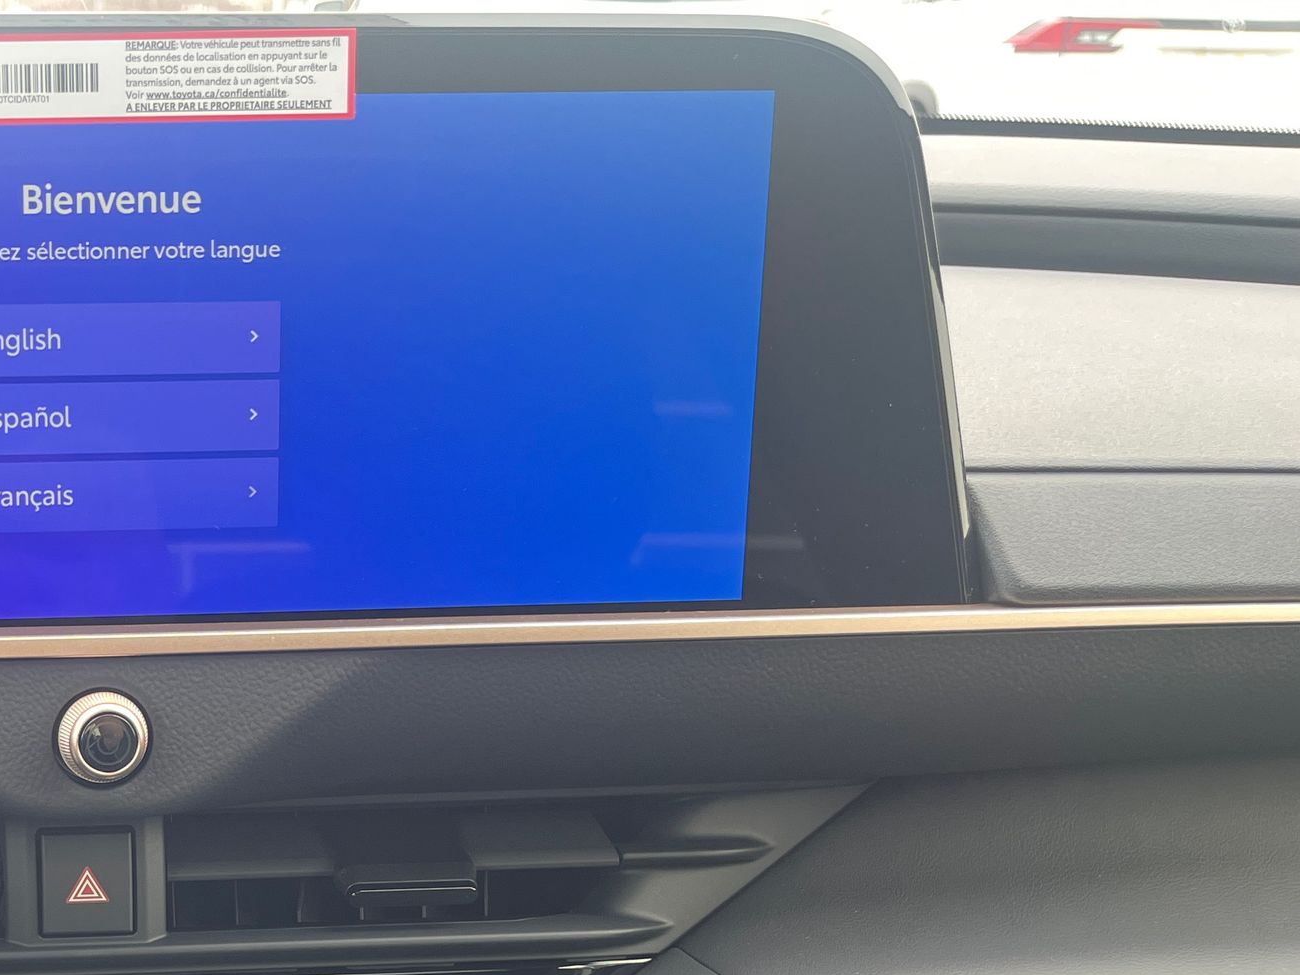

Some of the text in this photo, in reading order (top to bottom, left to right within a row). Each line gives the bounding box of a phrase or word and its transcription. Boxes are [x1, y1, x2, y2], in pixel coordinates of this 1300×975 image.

[125, 41, 178, 51] REMARQUE:
[180, 40, 202, 49] Votre
[204, 39, 238, 48] véhicule
[240, 40, 260, 50] peut
[262, 39, 310, 48] transmettre
[332, 38, 341, 47] fil
[125, 54, 141, 62] des
[143, 53, 180, 62] données
[183, 53, 194, 61] de
[196, 52, 245, 61] localisation
[261, 52, 302, 62] appuyant
[320, 51, 328, 59] le
[126, 66, 157, 75] bouton
[160, 65, 178, 74] SOS
[223, 64, 234, 73] de
[236, 64, 274, 73] collision.
[277, 64, 296, 72] Pour
[298, 63, 328, 72] arrêter
[329, 62, 337, 71] la
[126, 78, 183, 88] transmission,
[185, 77, 231, 86] demandez
[233, 77, 239, 85] à
[254, 77, 279, 87] agent
[281, 76, 293, 84] via
[295, 76, 316, 84] SOS.
[126, 91, 144, 99] Voir
[135, 102, 176, 112] ENLEVER
[178, 102, 196, 112] PAR
[198, 102, 208, 111] LE
[211, 101, 275, 111] PROPRIETAIRE
[277, 100, 332, 110] SEULEMENT
[22, 184, 202, 215] Bienvenue
[27, 241, 150, 260] sélectionner
[154, 242, 204, 259] votre
[211, 240, 281, 263] langue
